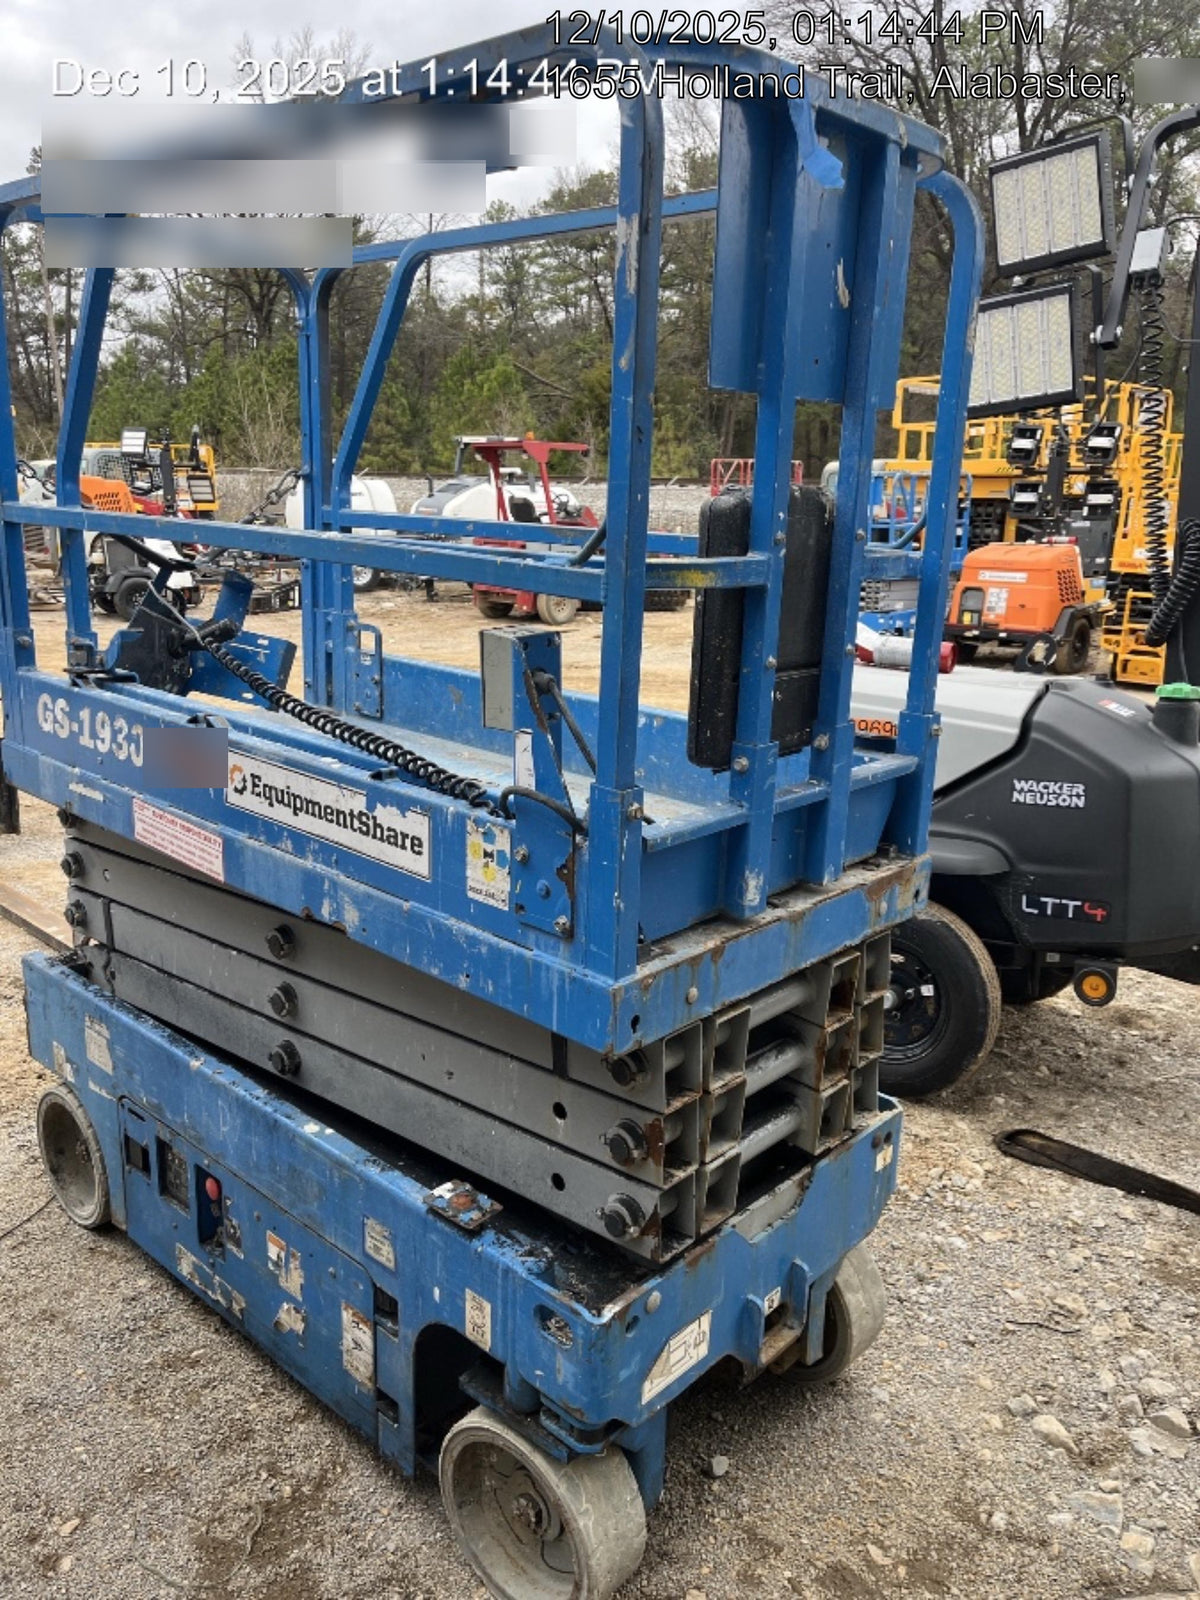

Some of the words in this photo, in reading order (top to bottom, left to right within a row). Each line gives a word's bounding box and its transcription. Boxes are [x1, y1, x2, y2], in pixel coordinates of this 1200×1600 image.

[1012, 778, 1086, 796] WACKER
[1011, 790, 1086, 809] NEUSON
[249, 772, 424, 856] EquipmentShare
[1021, 894, 1108, 922] LTT4
